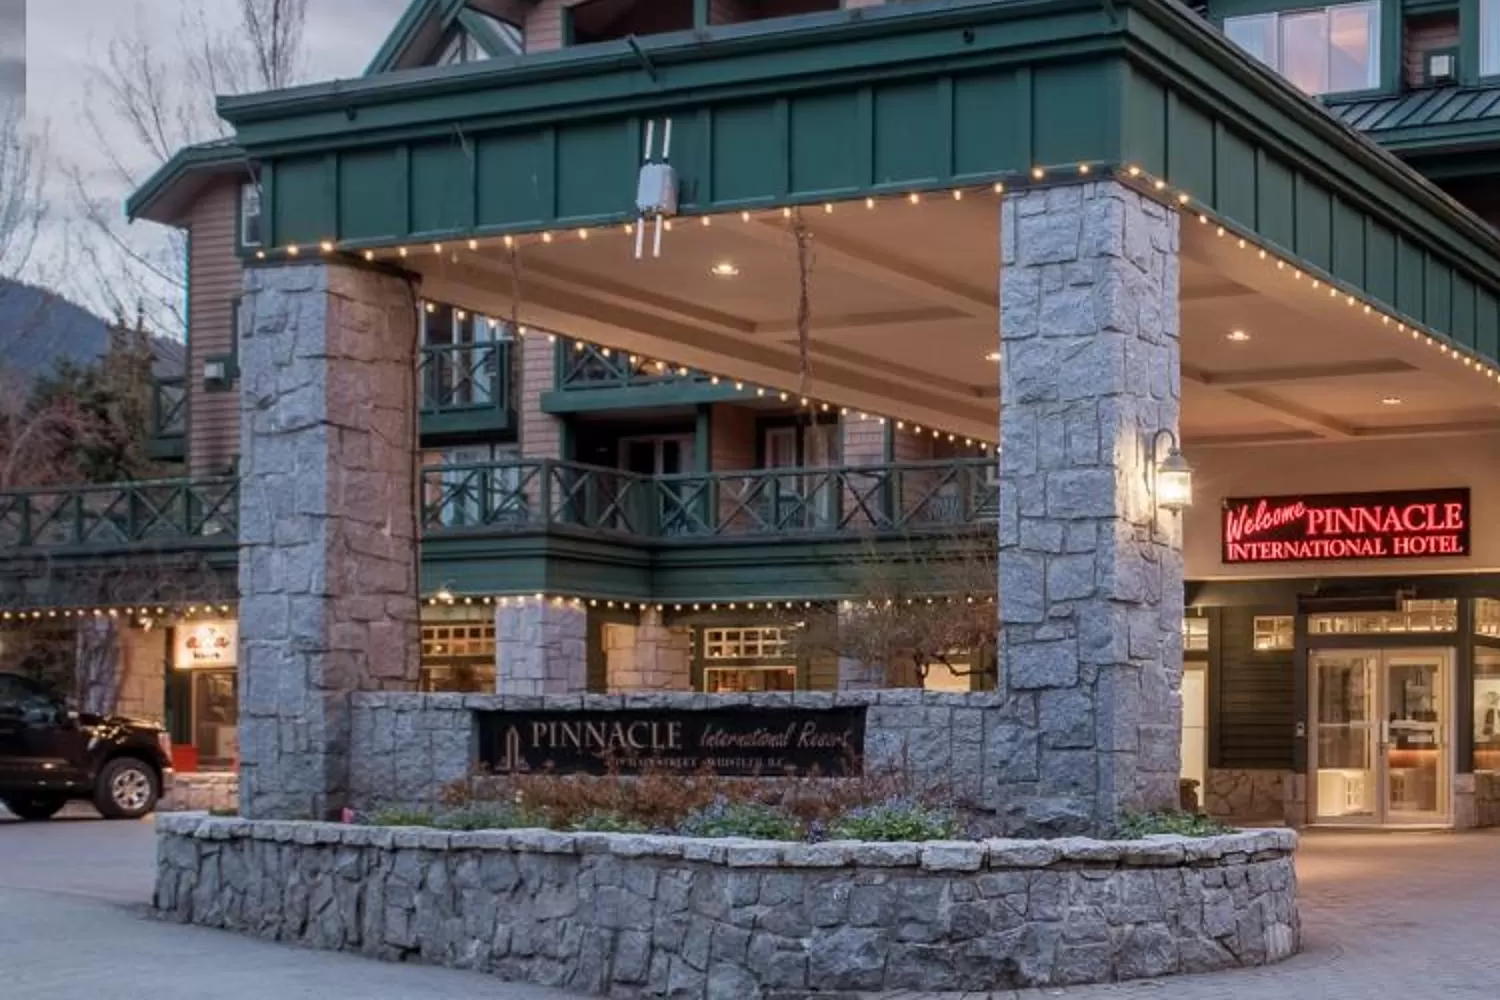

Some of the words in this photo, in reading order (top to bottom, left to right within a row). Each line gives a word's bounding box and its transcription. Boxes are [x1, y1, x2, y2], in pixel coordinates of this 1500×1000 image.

[1226, 500, 1304, 542] Welcome
[1305, 503, 1464, 535] PINNACLE
[1228, 537, 1387, 561] INTERNATIONAL
[1393, 535, 1464, 555] HOTEL
[532, 720, 682, 749] PINNACLE
[700, 721, 796, 747] International
